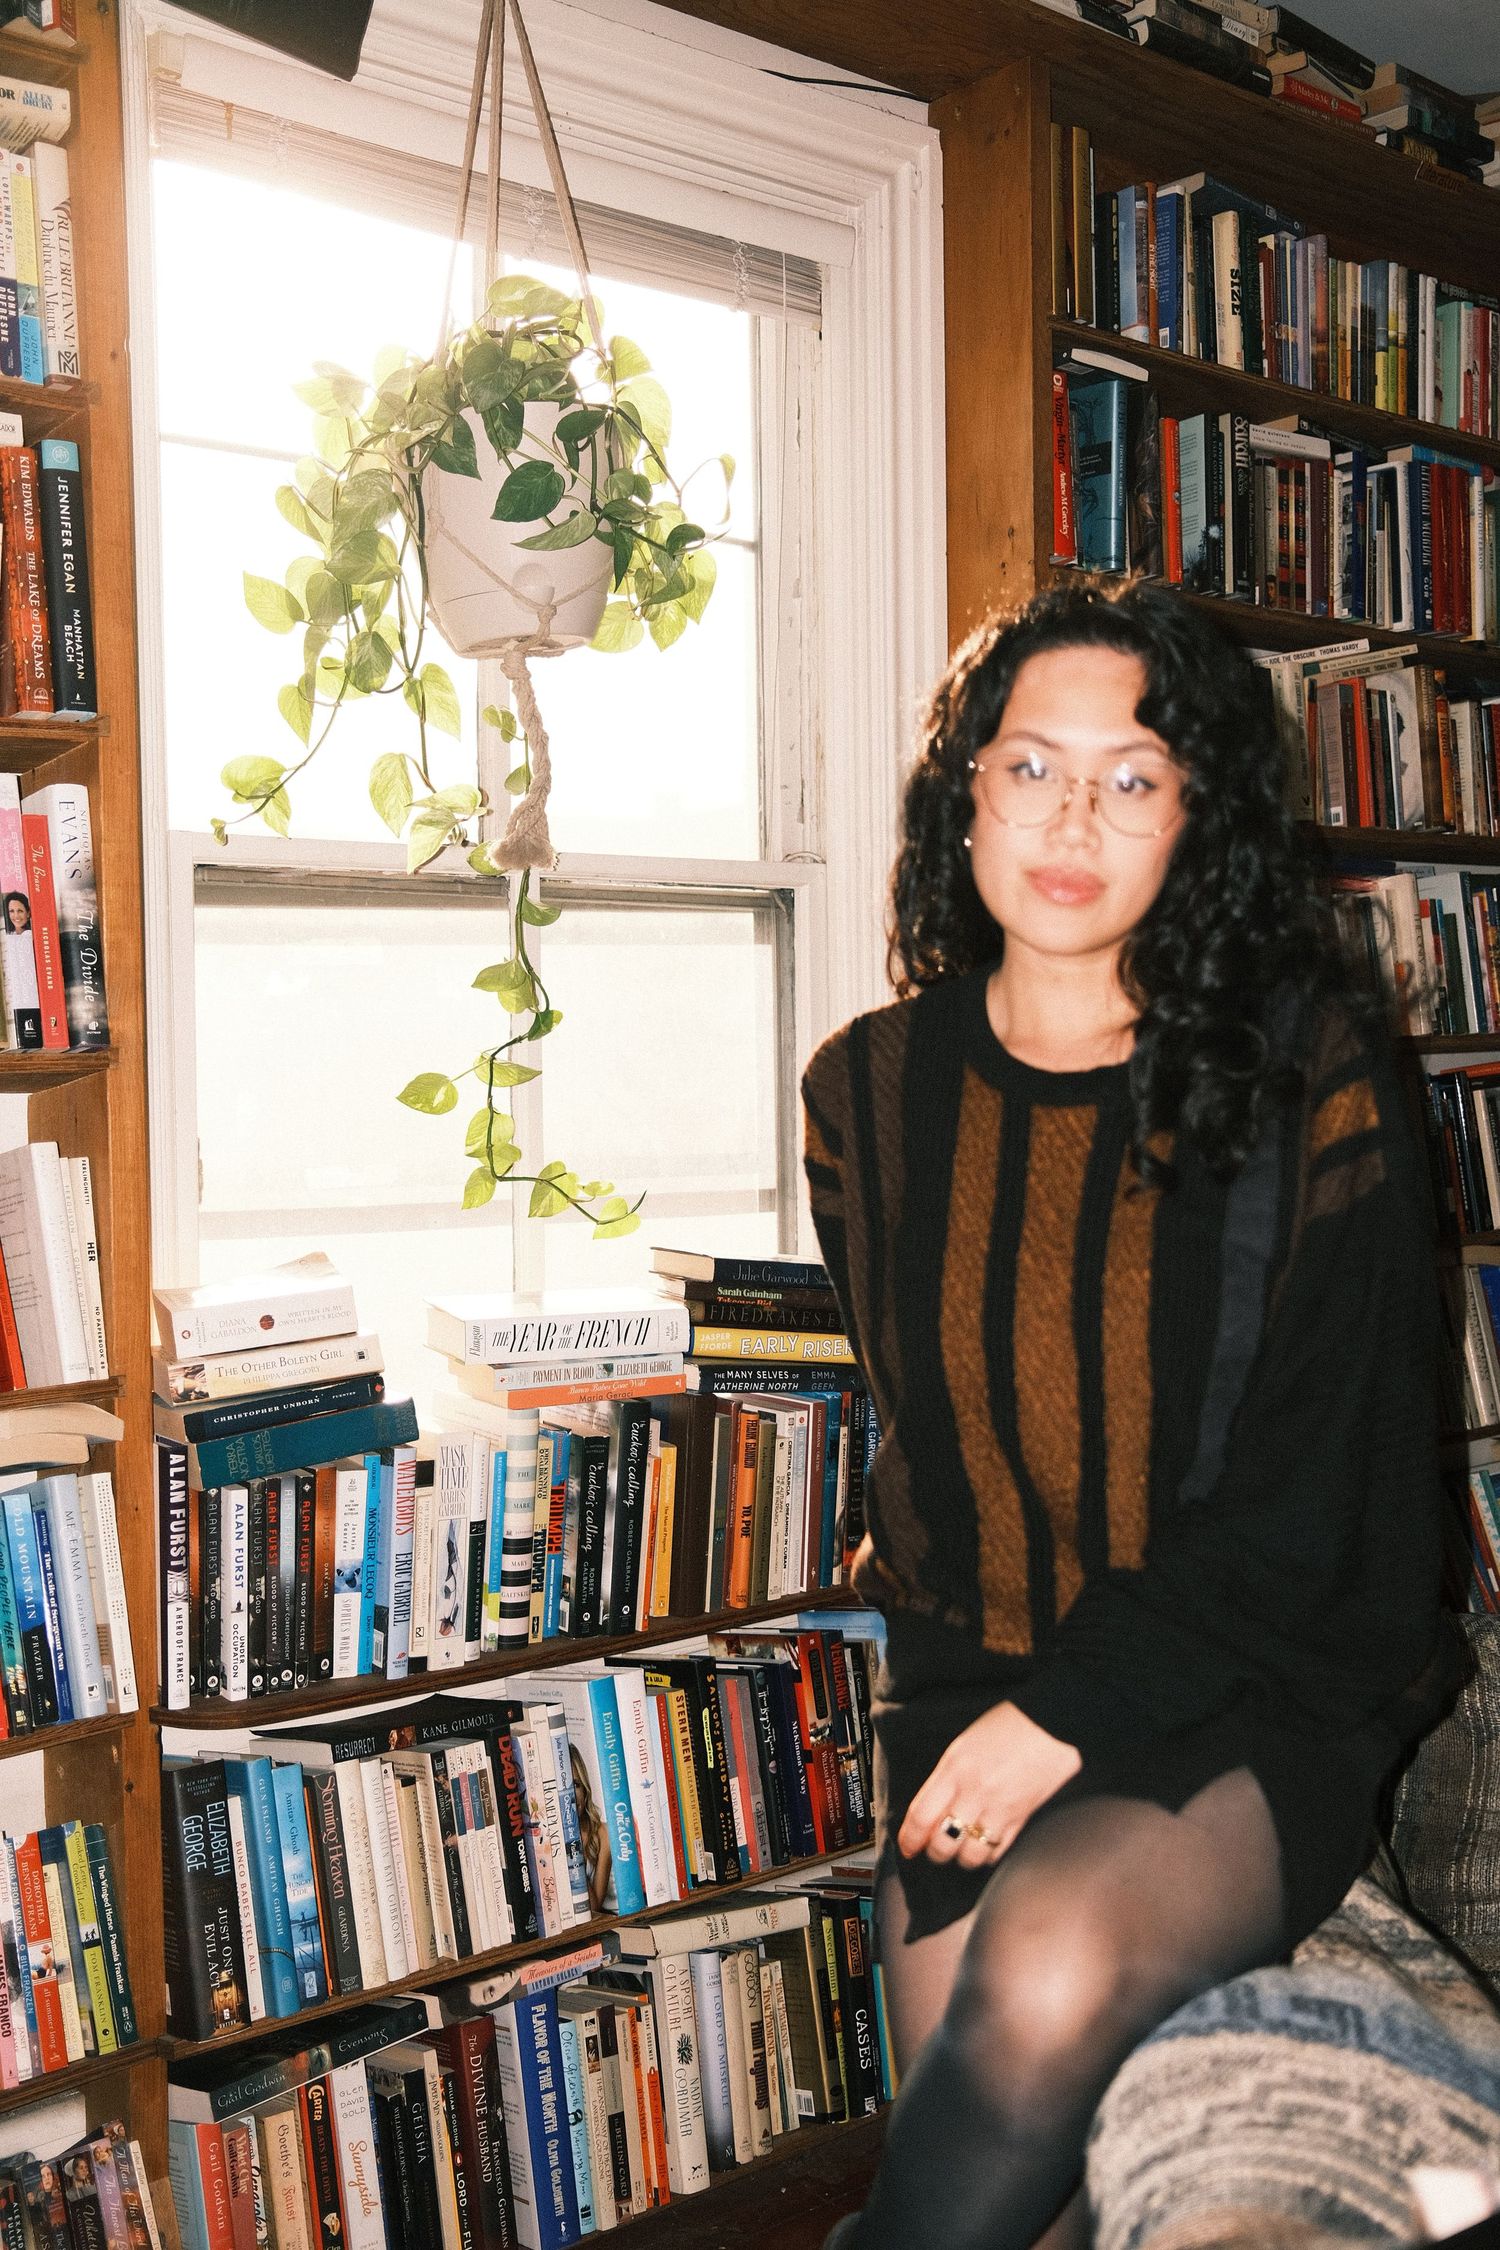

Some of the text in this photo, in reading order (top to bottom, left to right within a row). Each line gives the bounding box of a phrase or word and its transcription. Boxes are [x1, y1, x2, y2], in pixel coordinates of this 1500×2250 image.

[7, 288, 16, 317] JOHN
[21, 320, 32, 378] DUFRESNE
[20, 455, 35, 541] KIM EDWARDS
[58, 476, 76, 593] JENNIFER EGAN
[27, 552, 45, 679] THE LAKE OF DREAMS
[64, 624, 75, 663] BEACH
[73, 608, 85, 680] MANHATTAN
[1292, 650, 1316, 661] OBSCURE
[1319, 646, 1341, 657] THOMAS
[1341, 643, 1360, 653] HARDY
[31, 843, 47, 893] The Brave
[59, 801, 83, 880] EVANS
[77, 911, 100, 1002] The Divide
[81, 1159, 90, 1206] FERLINGHETTI
[86, 1242, 96, 1262] HER
[732, 1263, 810, 1286] Julie Garwood
[709, 1304, 822, 1327] FIREDRAKES
[717, 1286, 783, 1300] Sarah Gainham
[96, 1318, 105, 1359] PAPERBOOK
[215, 1349, 345, 1378] THE OTHER BOLEYN GIRL
[491, 1317, 652, 1353] THE YEAR OF THE FRENCH
[700, 1332, 732, 1341] JASPER
[740, 1335, 799, 1355] EARLY
[243, 1366, 321, 1385] PHILIPPA GREGORY
[532, 1366, 595, 1384] PAYMENT IN BLOOD
[578, 1391, 634, 1403] Maria Geraci
[616, 1359, 673, 1377] ELIZABETH GEORGE
[713, 1382, 800, 1391] KATHERINE NORTH
[726, 1370, 753, 1379] MANY
[756, 1371, 789, 1380] SELVES
[811, 1371, 837, 1379] EMMA
[811, 1383, 835, 1391] GEEN
[213, 1397, 321, 1424] CHRISTOPHER UNBORN
[626, 1421, 645, 1508] cuckoo's calling
[169, 1453, 186, 1574] ALAN FURST
[396, 1459, 417, 1536] WATERBOYS
[547, 1480, 567, 1554] TRIUMPH
[235, 1503, 244, 1588] ALAN FURST
[267, 1491, 278, 1567] ALAN FURST
[364, 1507, 377, 1599] MONSIEUR LECOQ
[18, 1543, 44, 1682] MOUNTAIN FRAZIER
[271, 1602, 277, 1612] OF
[393, 1552, 413, 1627] ERIC GABRIEL
[175, 1614, 183, 1636] HERO
[175, 1637, 183, 1648] OF
[176, 1652, 184, 1684] FRANCE
[334, 1736, 377, 1760] RESURRECT
[422, 1713, 495, 1739] KANE GILMOUR
[601, 1711, 621, 1792] Emily Giffin
[632, 1699, 648, 1774] Emily Giffin
[675, 1695, 692, 1763] STERN MEN
[259, 1778, 272, 1844] GUN ISLAND
[498, 1735, 524, 1838] DEAD RUN
[182, 1801, 231, 1876] ELIZABETH GEORGE
[517, 1839, 531, 1893] TONY GIBBS
[7, 1842, 25, 1937] HEARING FROM WAYNE
[22, 1861, 39, 1938] BENTON FRANK
[32, 1870, 45, 1925] DOROTHEA
[328, 1844, 346, 1899] Heaven
[98, 1865, 125, 1994] The Winged Horse Pamela Frankau
[235, 1841, 257, 1975] BUNCO BABES TELL ALL
[338, 1905, 350, 1953] GIARDINA
[204, 1923, 221, 1989] EVIL ACT
[217, 1907, 234, 1976] JUST ONE
[19, 1954, 34, 2014] BILL FRANZEN
[89, 1952, 108, 2024] TOM FRANKLIN
[0, 1993, 12, 2038] FRANCO
[339, 2027, 389, 2052] Evensong
[855, 2008, 871, 2070] CASES
[532, 2003, 558, 2135] FLAVOR OF THE MONTH
[713, 1994, 731, 2110] LORD OF MISRULE
[217, 2073, 287, 2109] Gail Godwin
[308, 2084, 325, 2121] CARTER
[470, 2054, 488, 2117] DIVINE
[412, 2103, 426, 2164] GEISHA
[477, 2121, 492, 2183] HUSBAND
[209, 2142, 226, 2231] Gail Godwin
[348, 2140, 378, 2217] Sunnyside
[456, 2172, 467, 2208] LORD
[492, 2141, 509, 2249] FRANCISCO GOLDMAN
